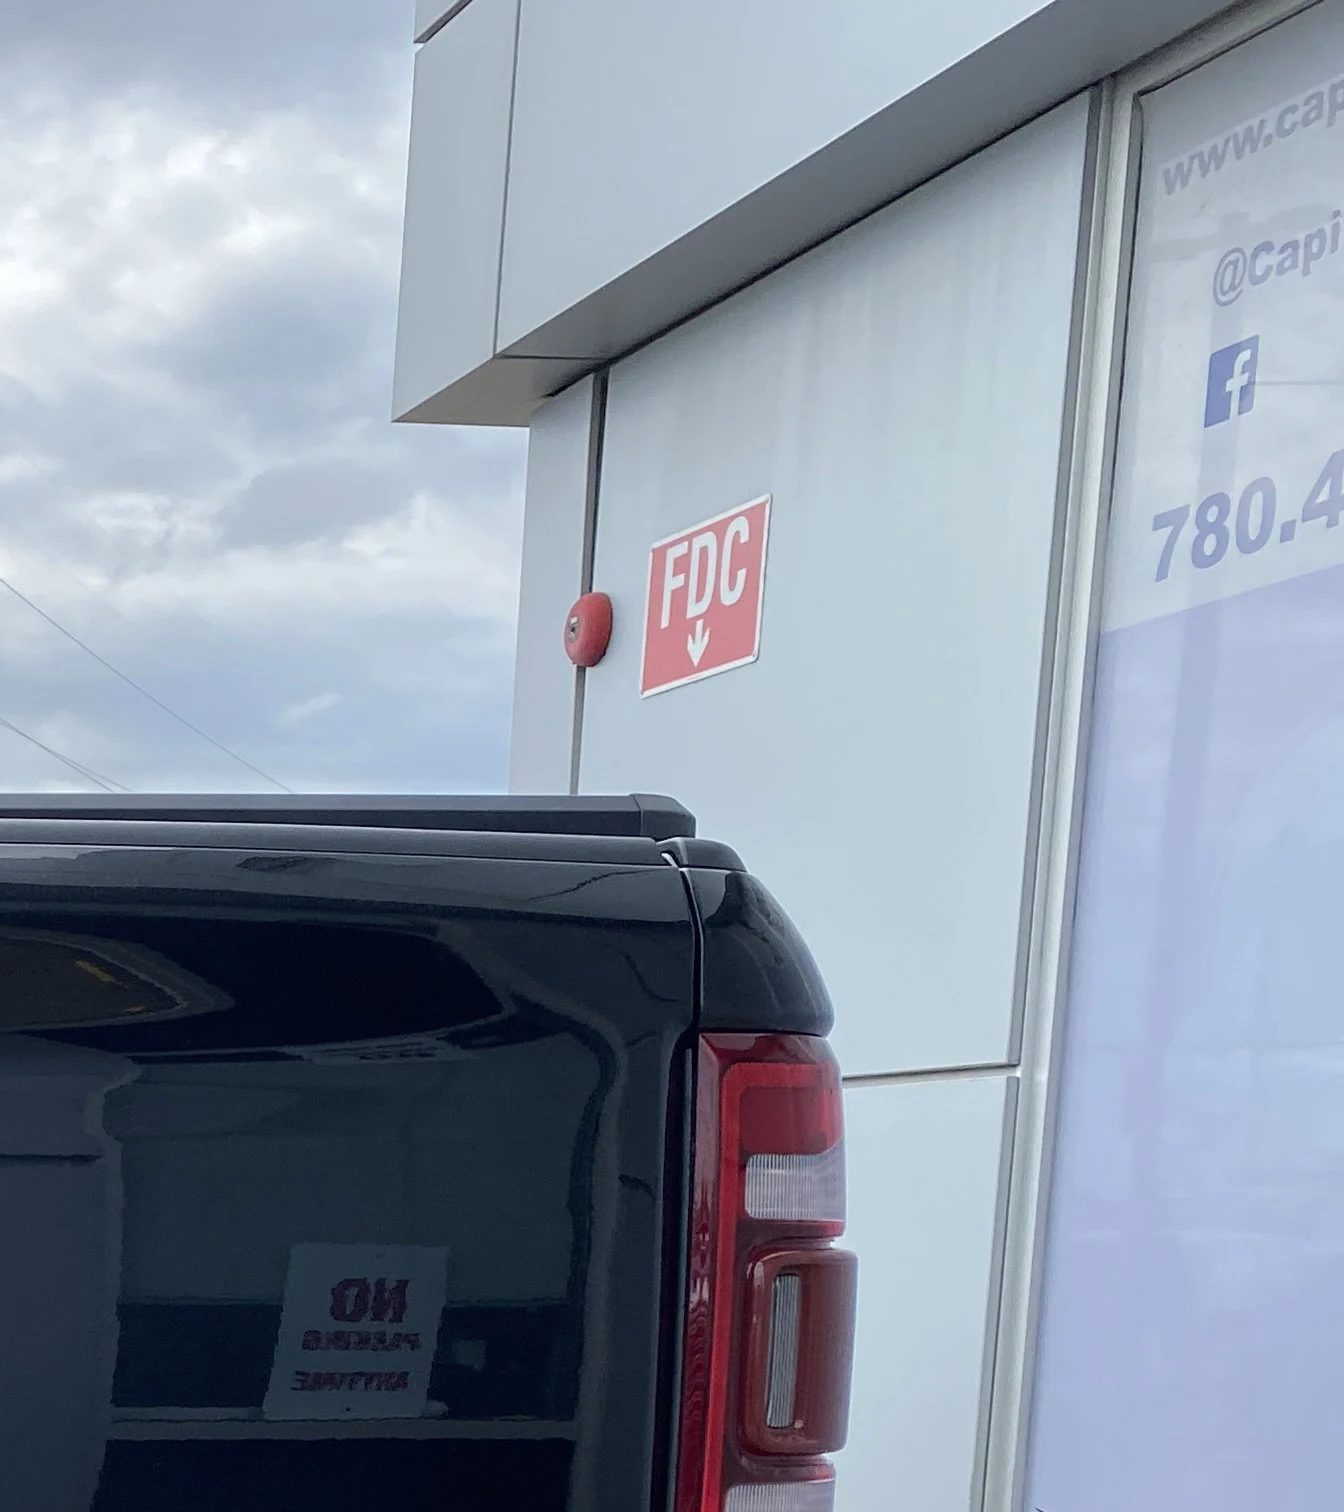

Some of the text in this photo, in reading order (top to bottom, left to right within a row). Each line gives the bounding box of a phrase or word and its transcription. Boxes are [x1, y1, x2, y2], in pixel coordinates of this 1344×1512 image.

[1212, 209, 1341, 307] @Capi
[660, 515, 750, 630] FDC
[1151, 448, 1344, 583] 780.4
